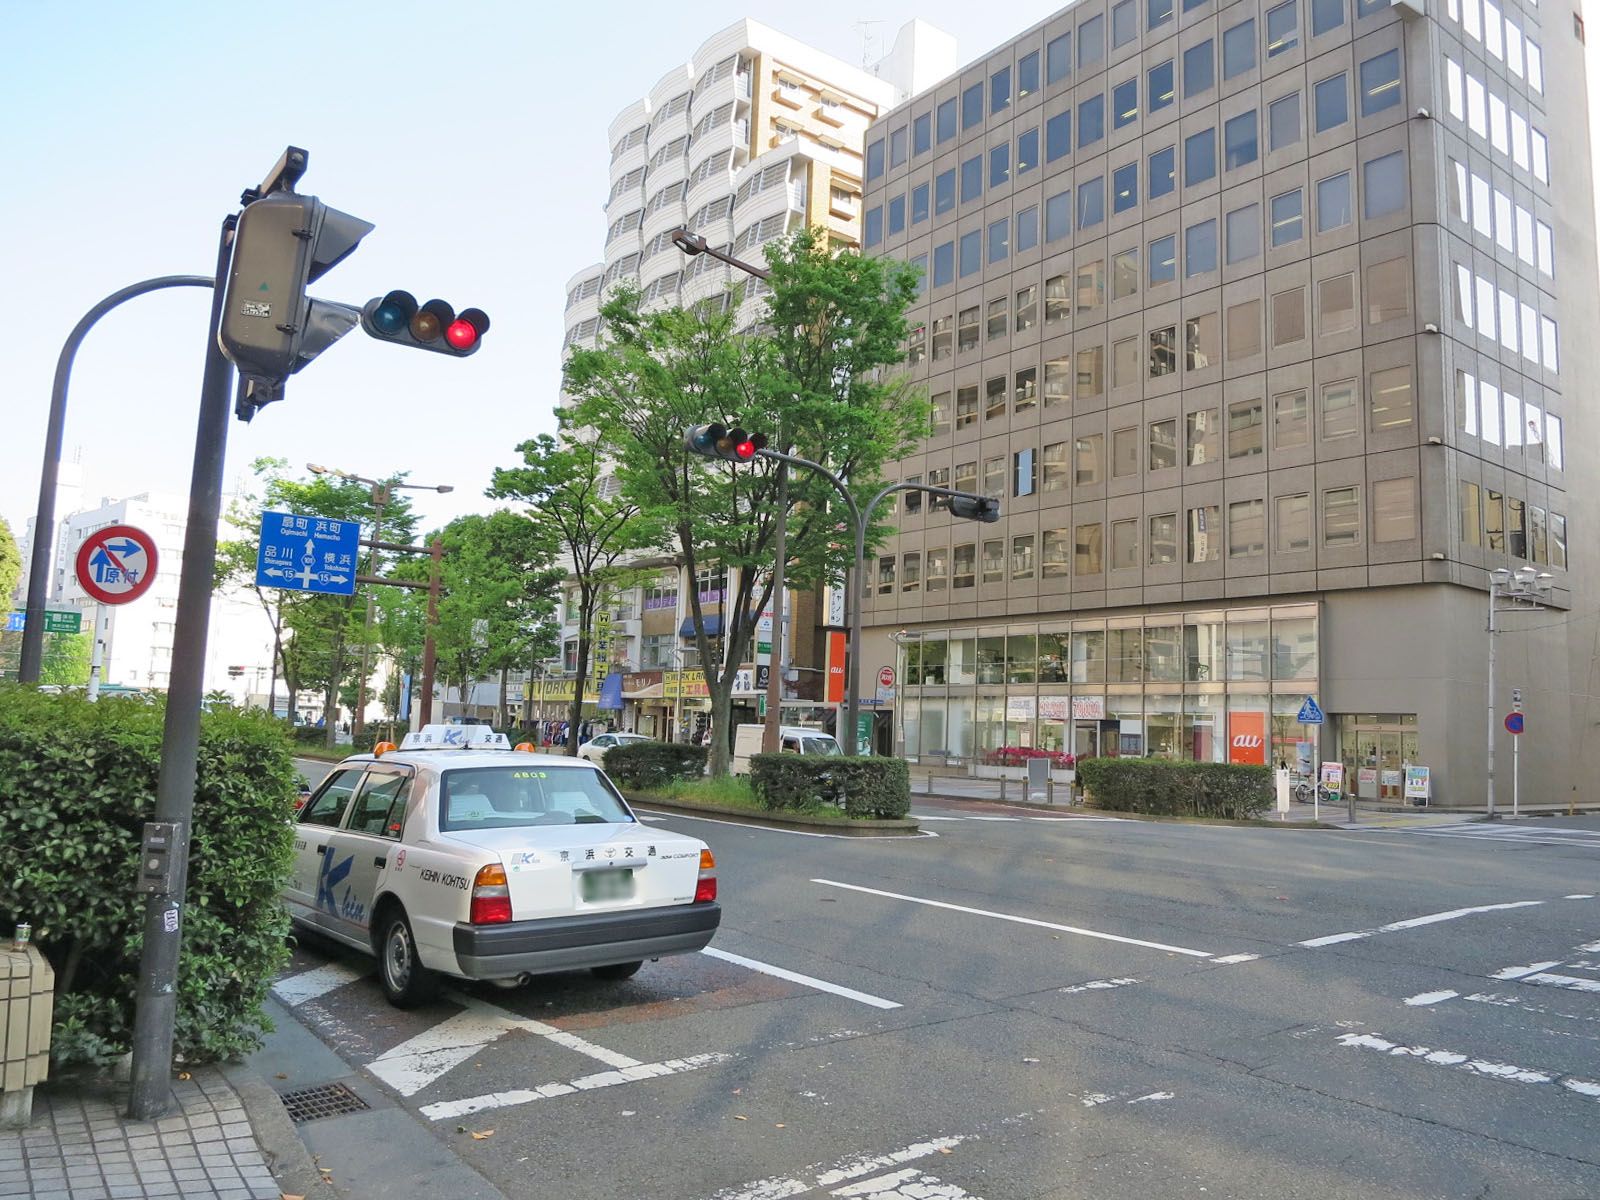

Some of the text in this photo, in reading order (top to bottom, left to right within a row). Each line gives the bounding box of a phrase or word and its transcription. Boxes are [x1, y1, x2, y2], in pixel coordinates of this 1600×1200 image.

[316, 520, 341, 534] 浜町
[281, 528, 341, 541] Ogimachi Hamacho
[265, 545, 293, 559] 品川
[264, 557, 292, 566] Shinagawa
[324, 552, 351, 565] 横浜
[285, 570, 293, 578] 15
[324, 564, 349, 573] Yokohama
[104, 567, 138, 585] 原付
[320, 574, 328, 582] 15
[413, 733, 433, 744] 京浜
[484, 734, 502, 744] 交通
[1233, 734, 1262, 748] au
[513, 770, 547, 779] 4803
[441, 872, 471, 891] KOHTSU
